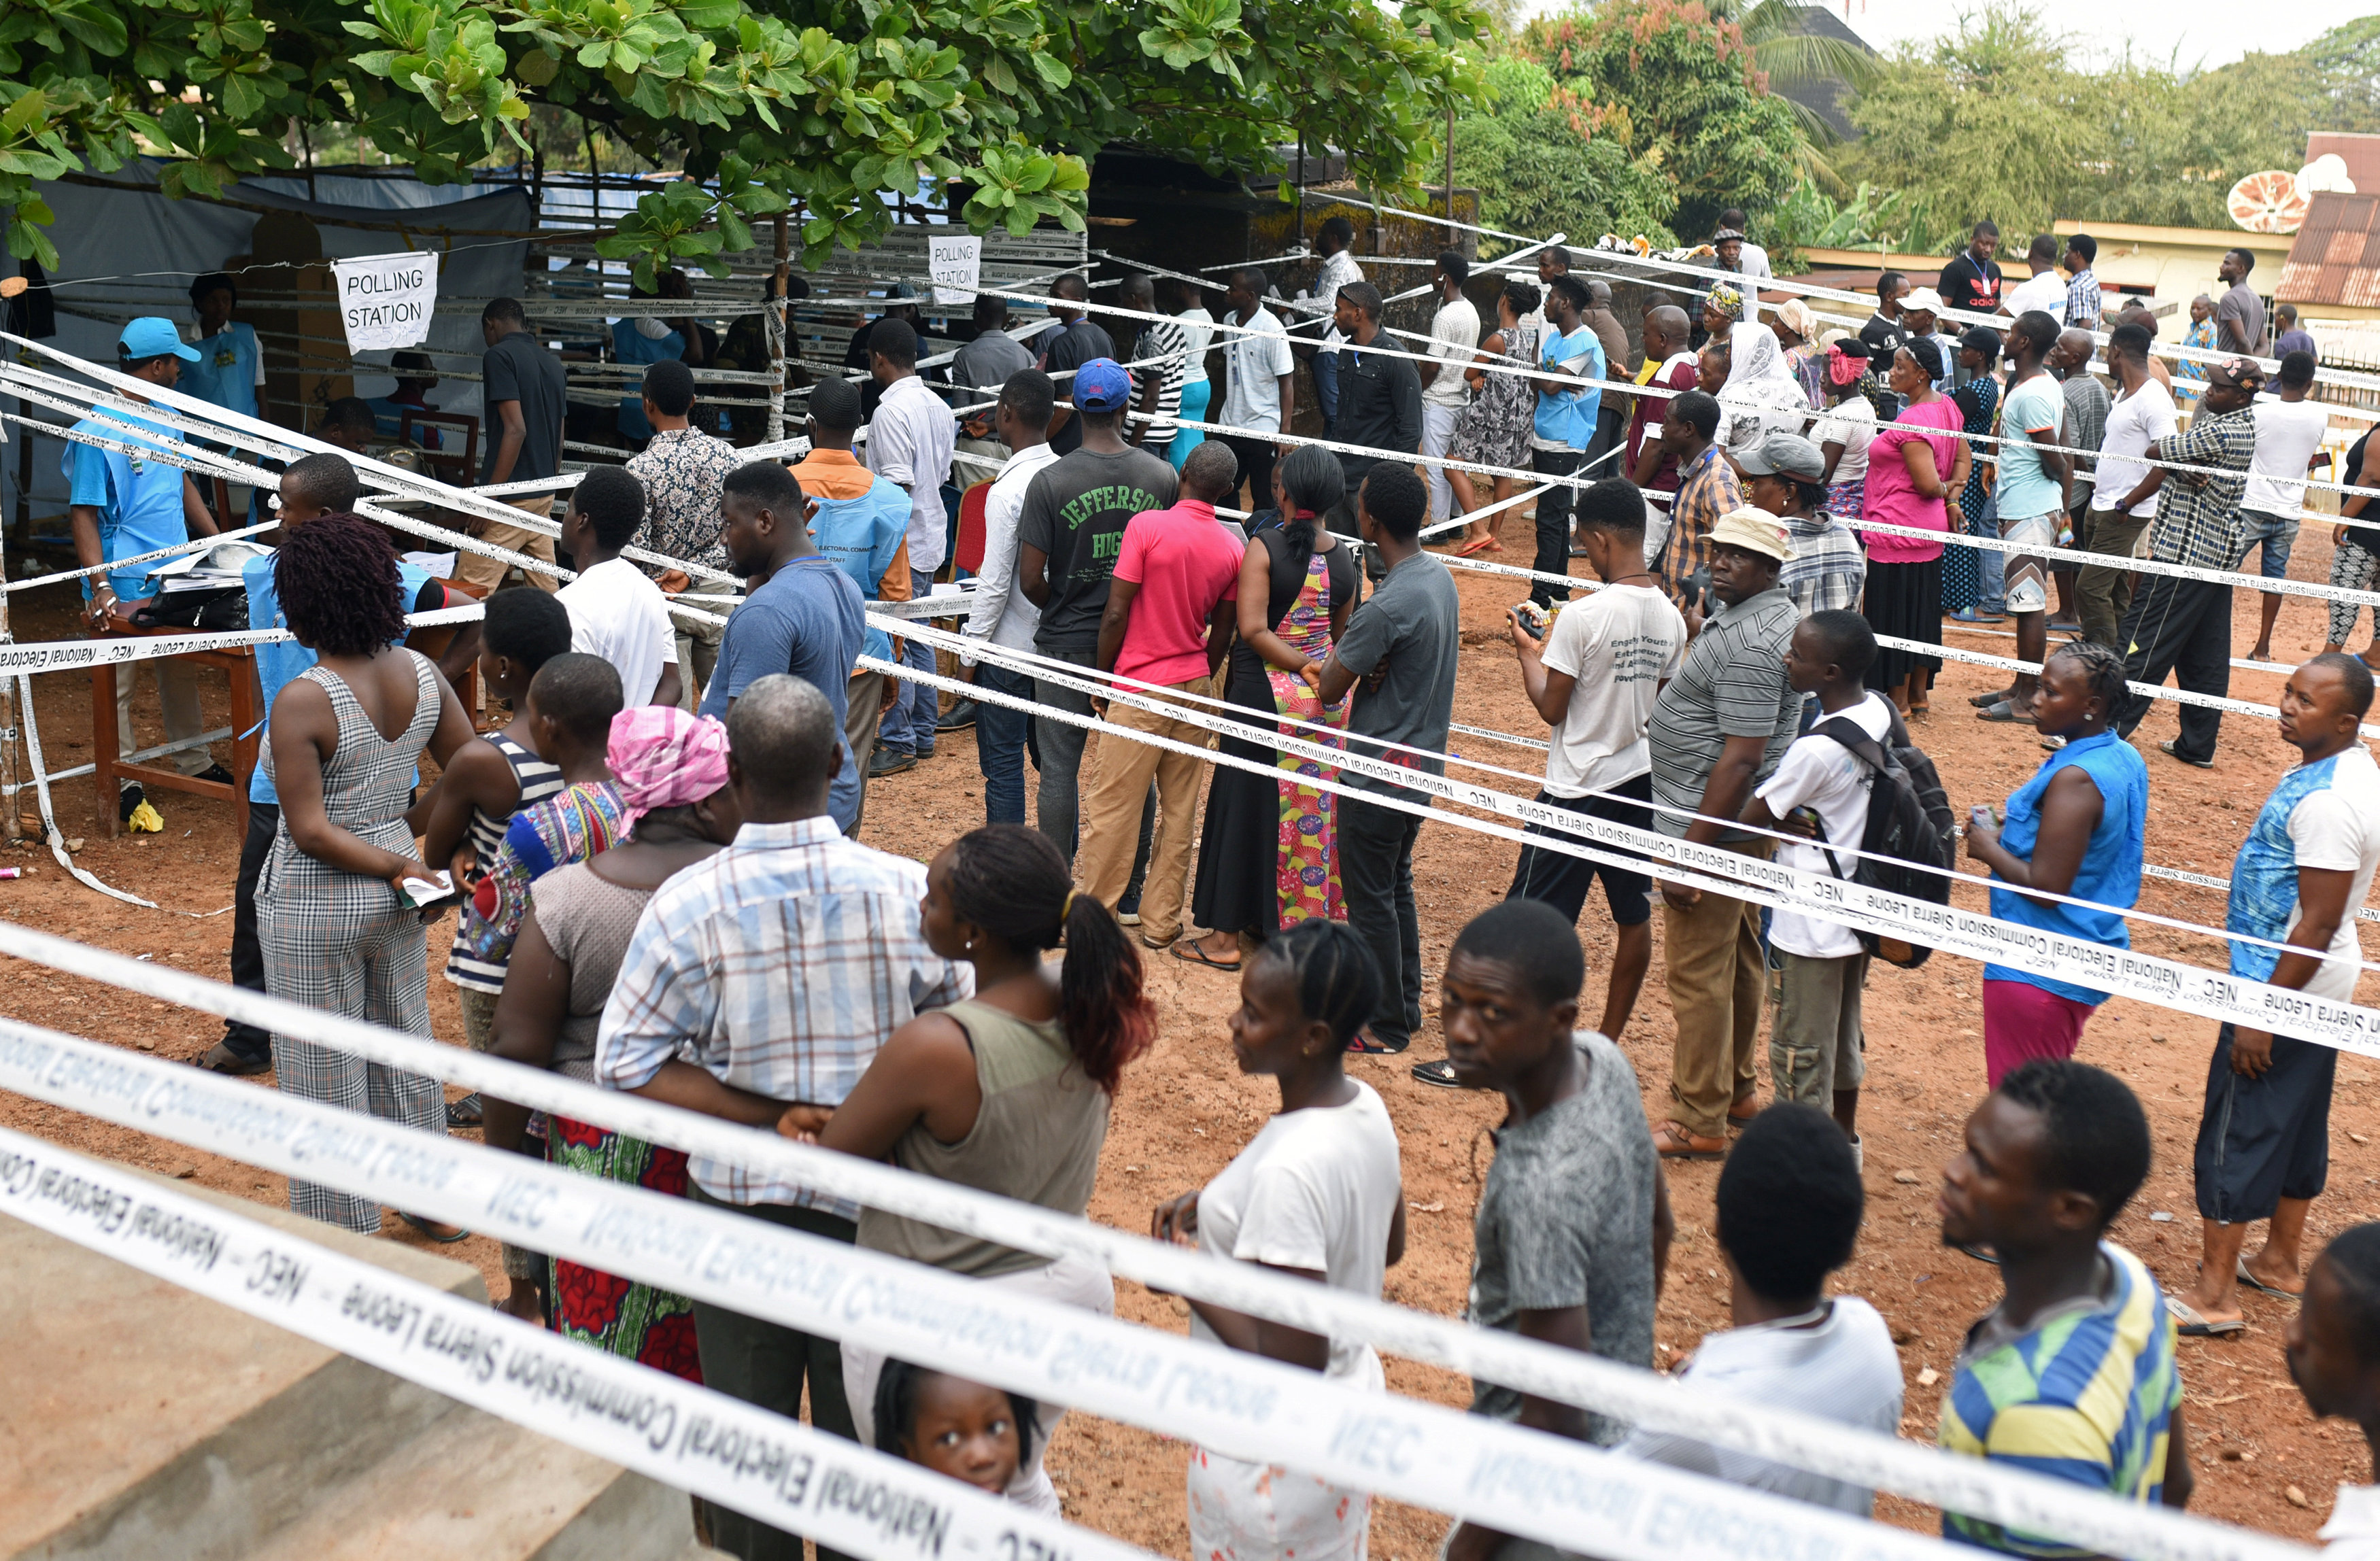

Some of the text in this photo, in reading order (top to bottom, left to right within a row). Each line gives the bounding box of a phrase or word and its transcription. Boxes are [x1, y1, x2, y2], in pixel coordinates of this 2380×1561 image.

[935, 245, 973, 262] POLLING
[348, 270, 423, 295] POLLING
[936, 269, 972, 284] STATION
[1840, 292, 1860, 301] National
[1969, 297, 1995, 307] adid
[348, 302, 422, 328] STATION
[1976, 315, 1997, 324] National
[2166, 346, 2229, 362] mmission Sierra Leone
[2315, 371, 2380, 385] mmission Sierra Leone
[583, 445, 600, 454] Sierra
[146, 450, 181, 468] National
[181, 460, 218, 478] Electoral
[1092, 531, 1125, 559] HIG
[1945, 536, 1964, 546] NEC
[1978, 541, 2004, 551] Leone
[2006, 545, 2032, 555] Sierra
[2034, 549, 2089, 562] Commission
[2092, 556, 2130, 570] Electoral
[1474, 562, 1565, 586] NEC National Electoral
[2135, 562, 2171, 576] National
[2183, 570, 2203, 581] NEC
[2219, 574, 2247, 585] Leone
[2249, 580, 2278, 592] Sierra
[2281, 584, 2340, 600] Commission
[2343, 592, 2380, 606] lectoral
[151, 642, 184, 654] Leone
[186, 639, 217, 652] Sierra
[1641, 635, 1667, 647] Youth
[48, 648, 97, 666] National
[112, 645, 135, 659] NEC
[1923, 648, 1958, 659] National
[1960, 654, 1998, 668] Electoral
[2160, 691, 2241, 713] National Electoral
[1164, 708, 1189, 722] NEC
[1206, 719, 1238, 736] Leone
[1242, 729, 1276, 748] Sierra
[1278, 739, 1348, 768] Commission
[1351, 758, 1402, 783] Electoral
[1405, 773, 1453, 797] National
[1470, 791, 1496, 810] NEC
[1517, 802, 1554, 825] Leone
[1558, 814, 1594, 836] Sierra
[1599, 825, 1676, 859] Commission
[1680, 847, 1737, 875] Electoral
[1741, 865, 1795, 890] National
[2149, 865, 2230, 889] mmission Sierra
[1814, 881, 1844, 903] NEC
[1866, 895, 1907, 921] Leone
[1912, 905, 1954, 931] Sierra
[1958, 917, 2047, 955] Commission
[1948, 940, 2007, 958] National
[2052, 940, 2116, 974] Electoral
[2025, 955, 2060, 971] NEC
[2084, 969, 2129, 987] Leone
[2121, 958, 2183, 989] National
[2133, 980, 2177, 1001] Sierra
[2203, 978, 2239, 1002] NEC
[2264, 992, 2365, 1033] Sierra Leone
[34, 1157, 133, 1235] Electoral
[136, 1197, 231, 1272] National
[247, 1249, 313, 1306] NEC
[341, 1284, 418, 1340] Leone
[422, 1320, 505, 1384] Sierra
[505, 1345, 677, 1451] Commission
[681, 1409, 816, 1505] Electoral
[813, 1465, 951, 1558] National
